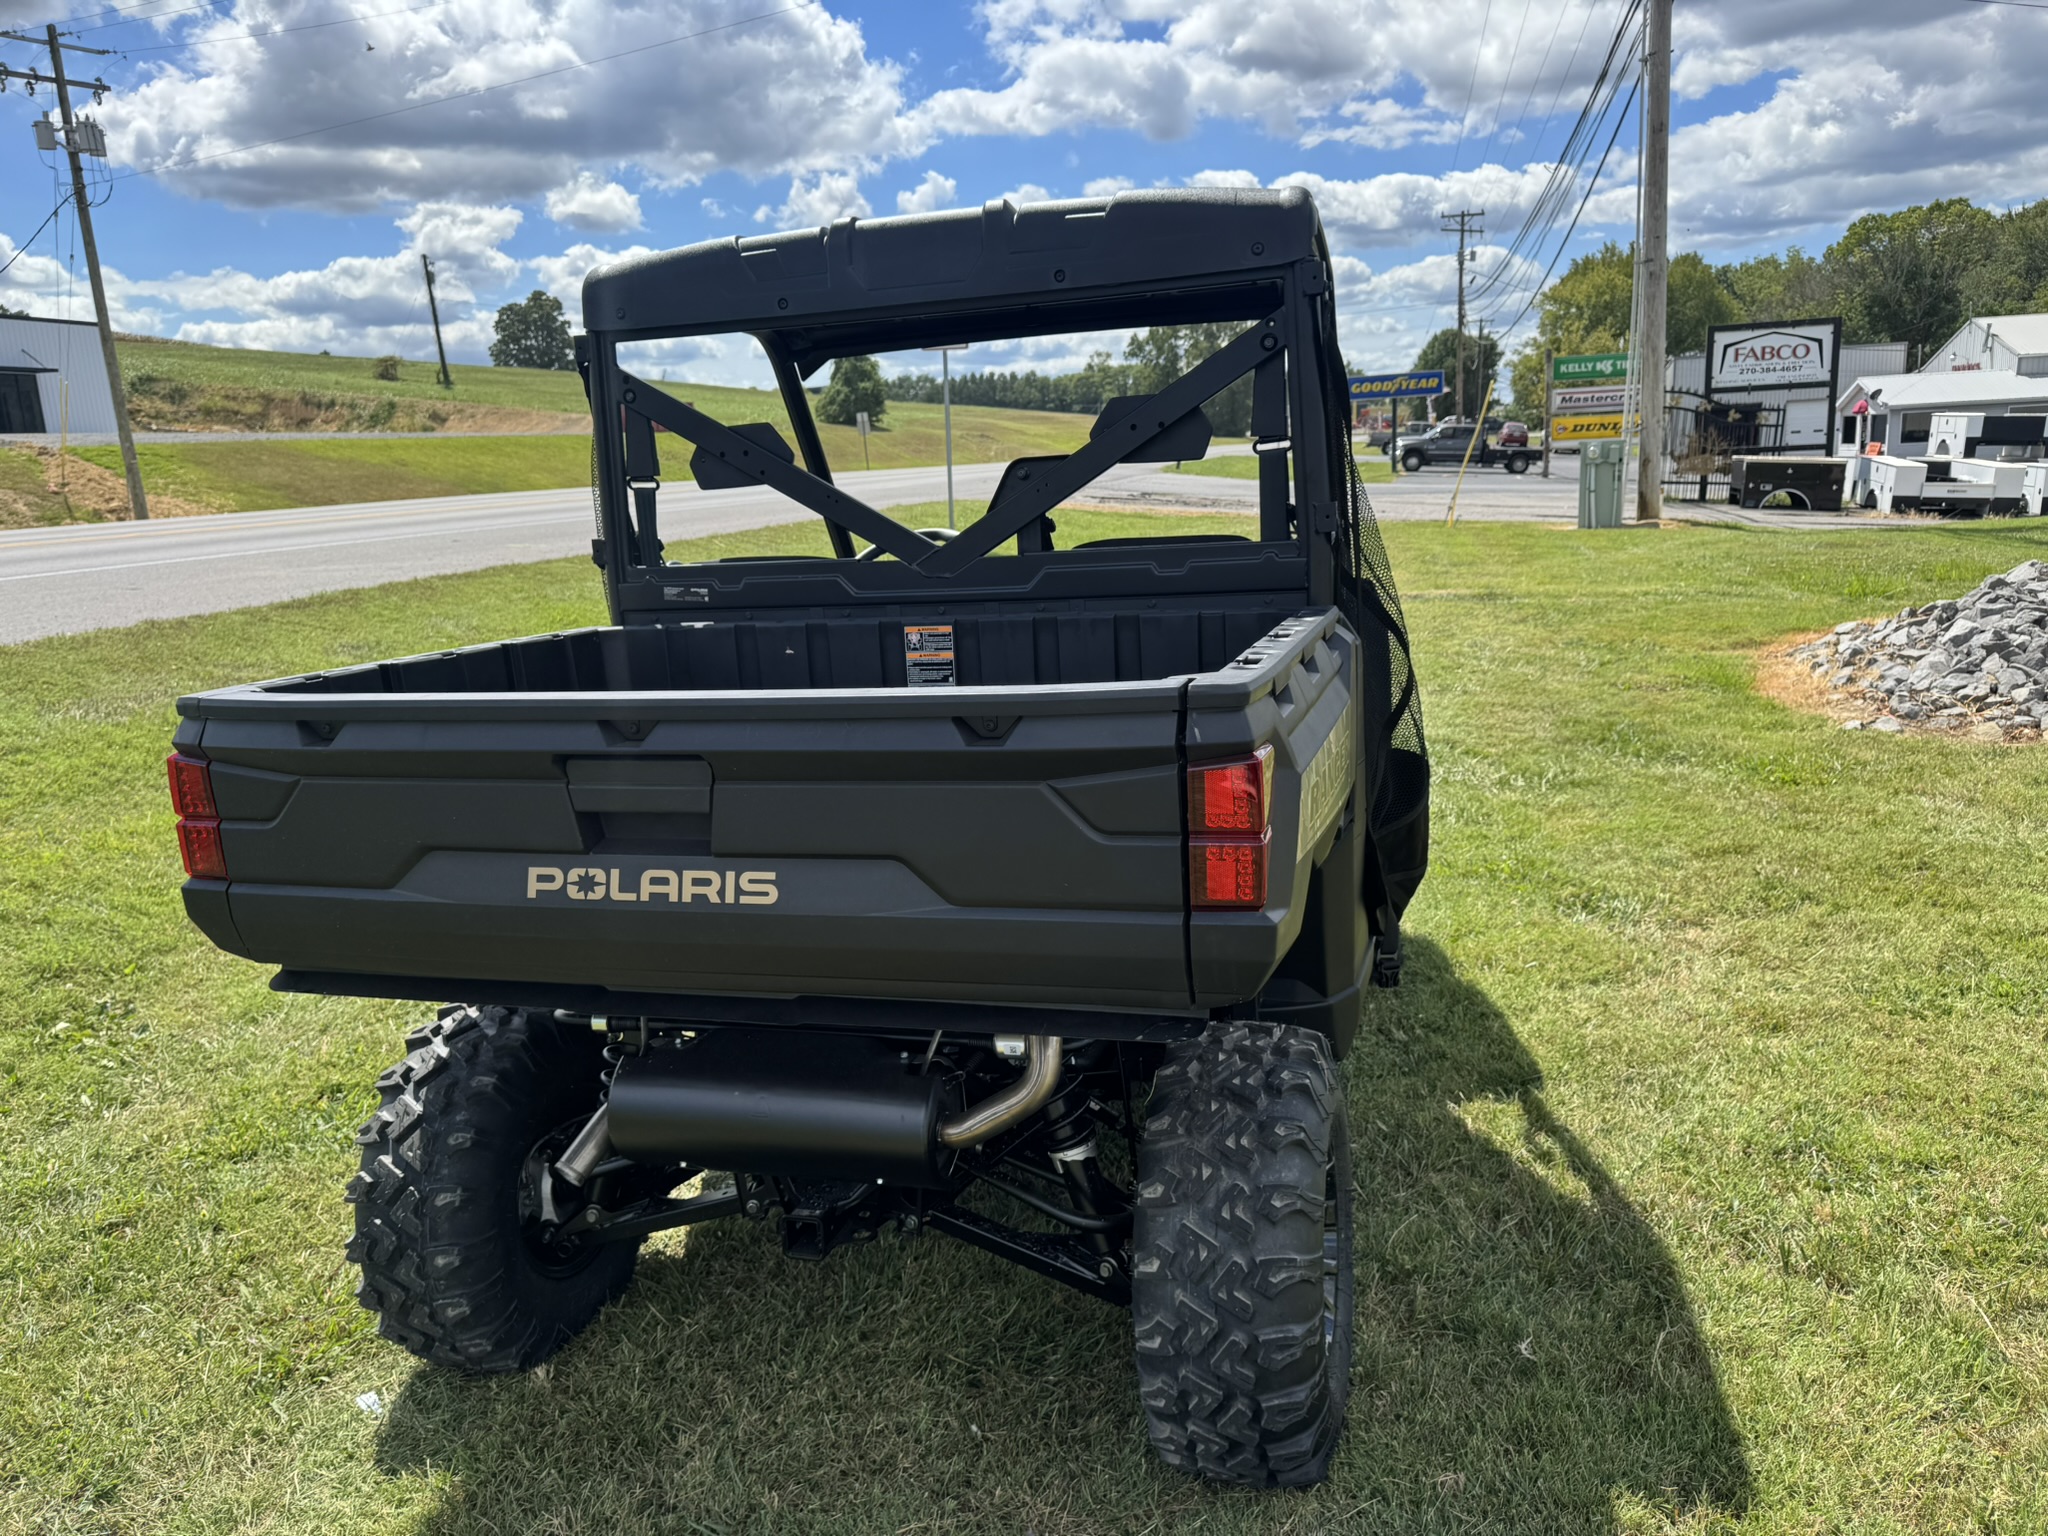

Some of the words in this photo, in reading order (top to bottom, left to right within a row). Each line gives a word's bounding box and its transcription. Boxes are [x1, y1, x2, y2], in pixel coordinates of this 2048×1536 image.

[1733, 343, 1811, 363] FABCO
[1560, 362, 1594, 374] KELLY
[1739, 365, 1803, 375] 270-384-4657
[1351, 377, 1439, 394] GOODYEAR
[1560, 394, 1640, 405] Mastercr
[1570, 421, 1641, 434] DUNL
[526, 866, 779, 905] POLARIS
